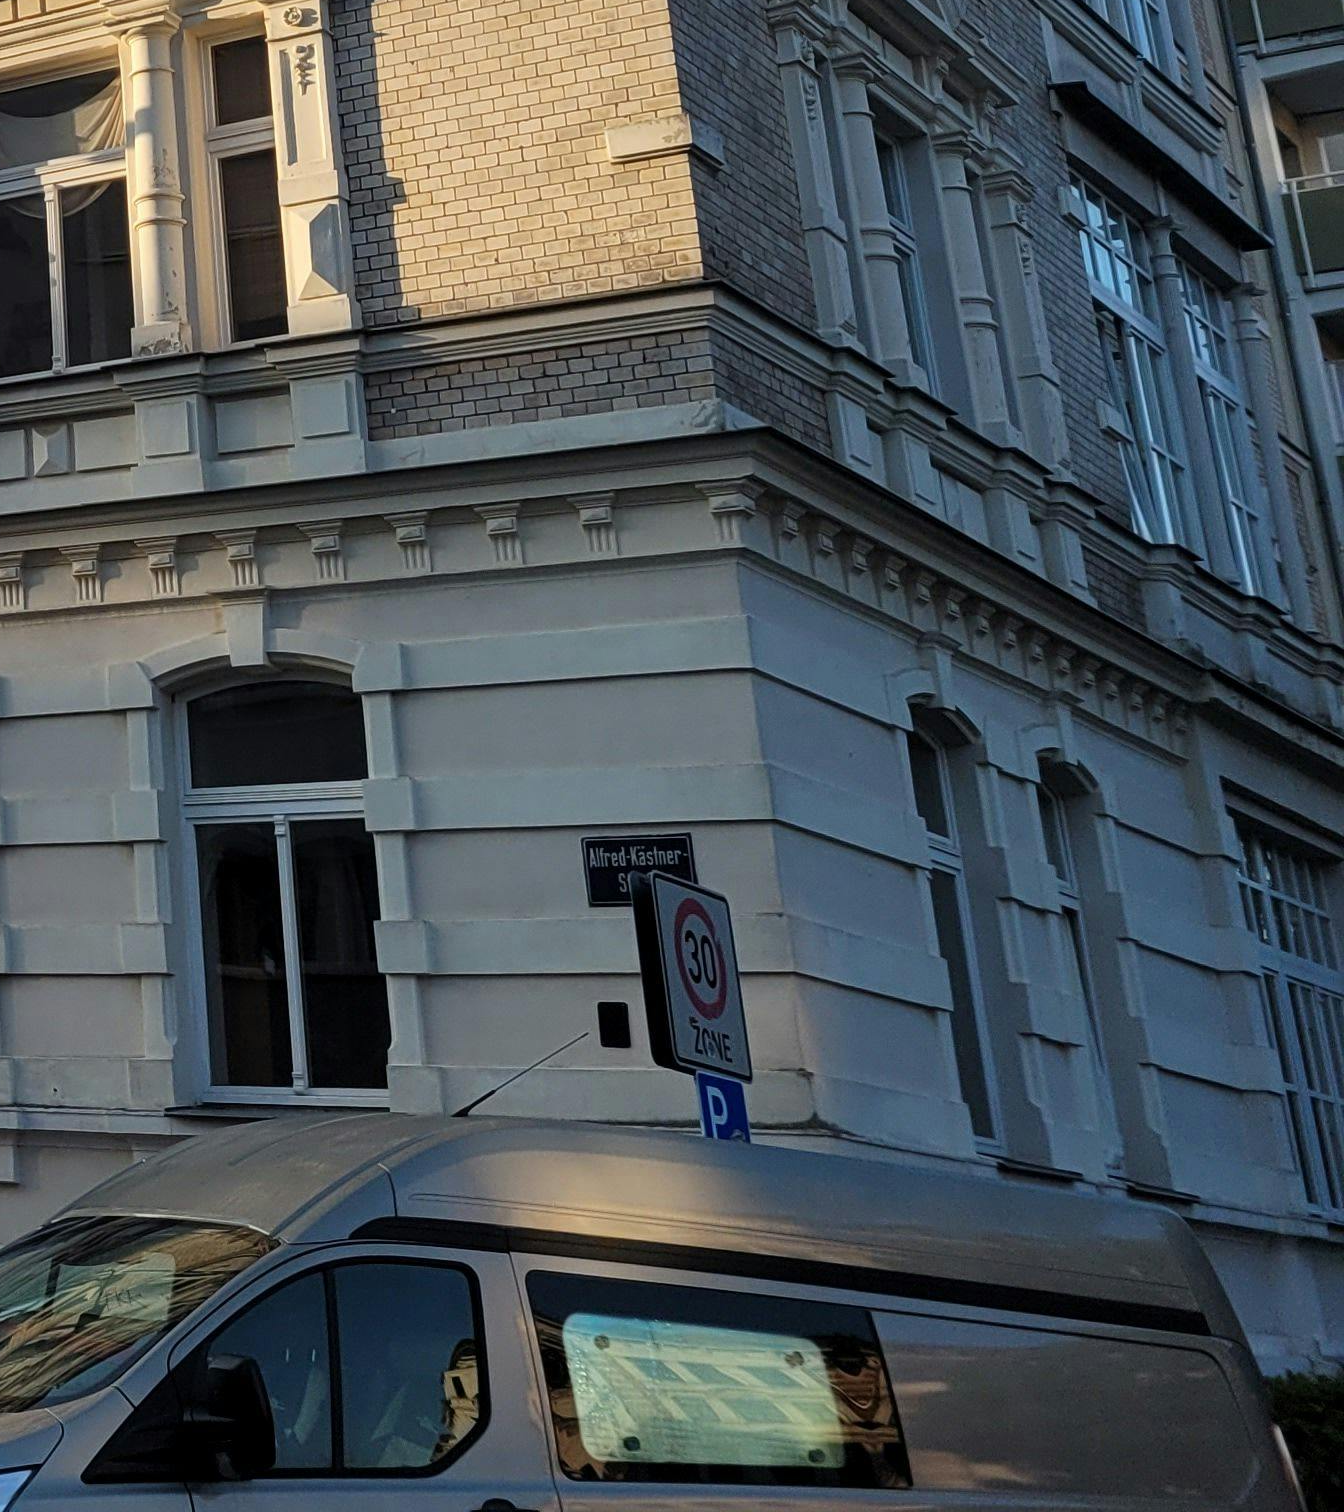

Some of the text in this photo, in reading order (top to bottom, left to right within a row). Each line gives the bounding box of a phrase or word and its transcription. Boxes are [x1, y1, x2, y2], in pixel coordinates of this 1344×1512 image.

[589, 845, 689, 868] Alfred-Kästner-
[684, 929, 718, 989] 30
[690, 1024, 734, 1064] ZONE
[705, 1085, 729, 1140] P
